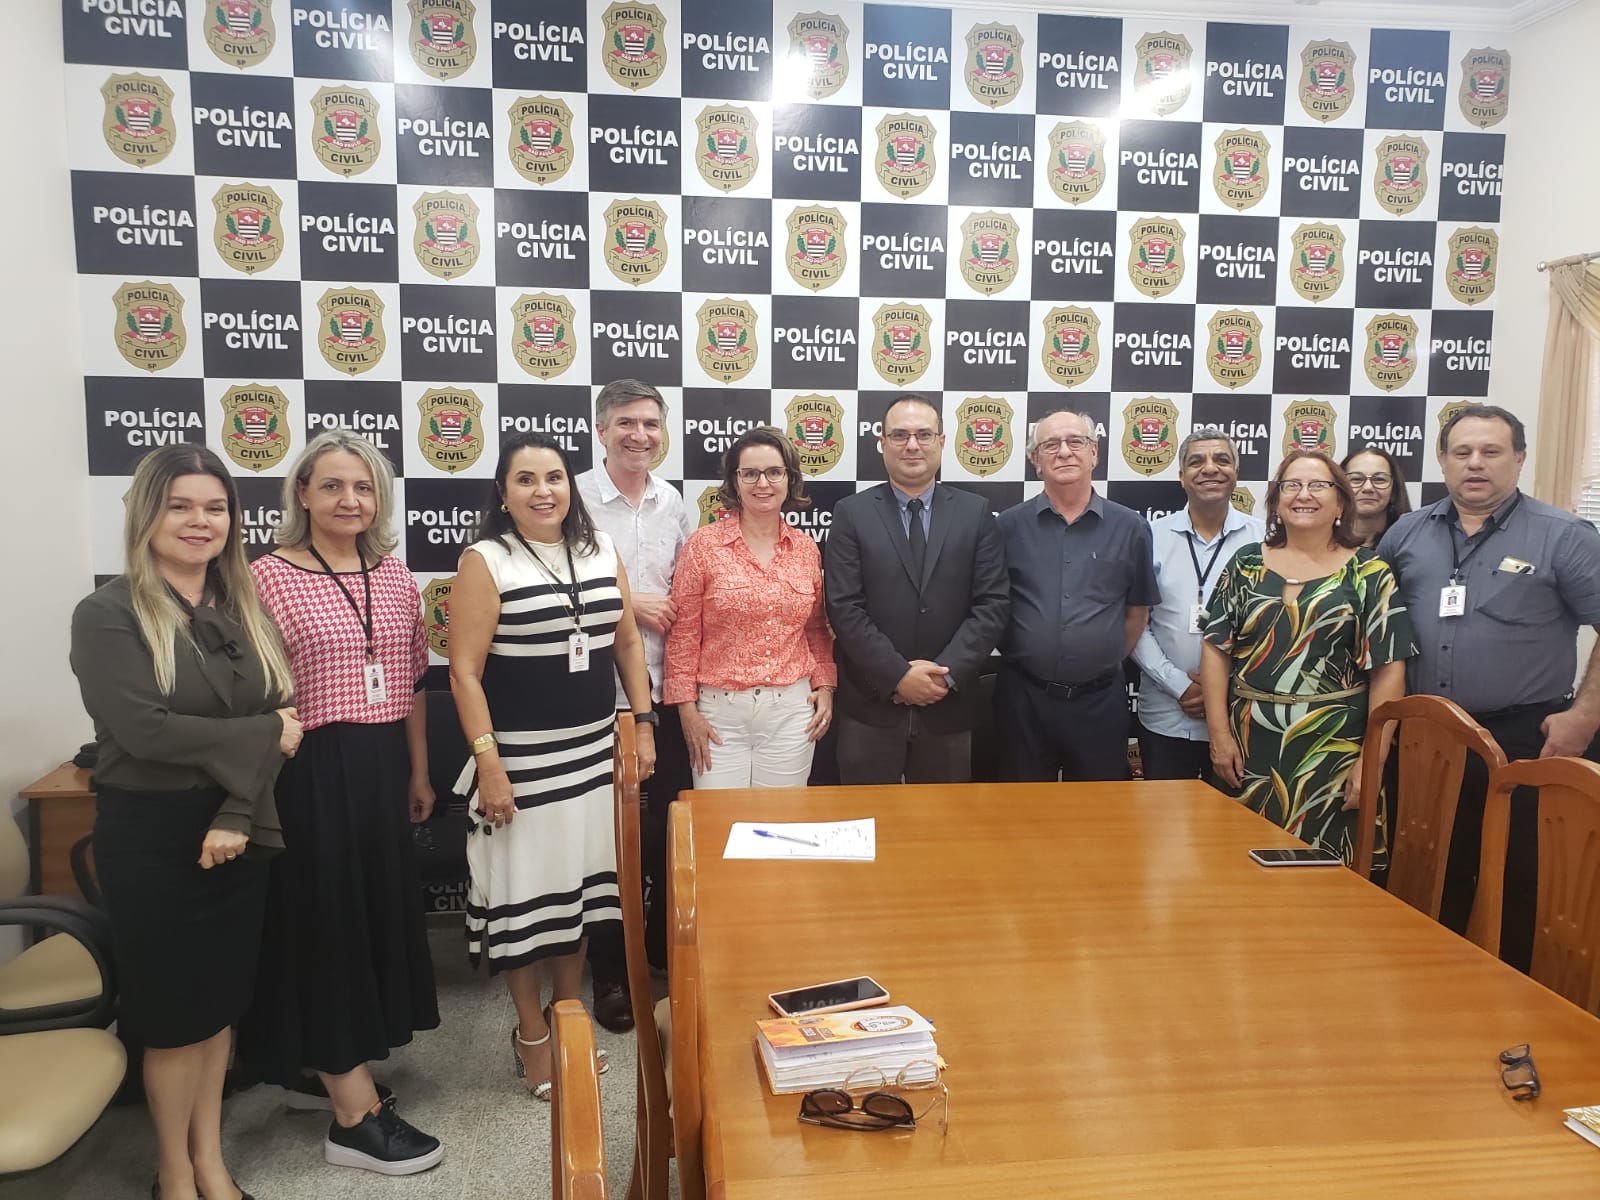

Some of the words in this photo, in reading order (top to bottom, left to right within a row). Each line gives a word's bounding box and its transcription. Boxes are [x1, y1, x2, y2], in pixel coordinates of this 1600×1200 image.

[294, 8, 389, 31] POLÍCIA
[615, 8, 653, 22] POLÍCIA
[105, 17, 171, 37] CIVIL
[494, 21, 585, 44] POLÍCIA
[800, 19, 836, 32] POLÍCIA
[315, 30, 378, 50] CIVIL
[683, 31, 770, 53] POLÍCIA
[977, 29, 1012, 42] POLÍCIA
[223, 43, 257, 54] CIVIL
[1147, 38, 1180, 51] POLÍCIA
[514, 43, 574, 62] CIVIL
[865, 41, 948, 63] POLÍCIA
[1312, 47, 1344, 59] POLÍCIA
[427, 56, 459, 67] CIVIL
[702, 53, 759, 72] CIVIL
[1039, 51, 1118, 72] POLÍCIA
[619, 67, 650, 77] CIVIL
[883, 62, 937, 81] CIVIL
[1207, 59, 1283, 80] POLÍCIA
[1055, 72, 1108, 90] CIVIL
[1370, 67, 1444, 87] POLÍCIA
[116, 81, 158, 95] POLÍCIA
[979, 86, 1008, 95] CIVIL
[1223, 79, 1273, 97] CIVIL
[1385, 86, 1434, 103] CIVIL
[324, 93, 365, 107] POLÍCIA
[1312, 101, 1339, 110] CIVIL
[521, 103, 560, 116] POLÍCIA
[195, 106, 292, 129] POLÍCIA
[708, 112, 745, 124] POLÍCIA
[398, 116, 490, 138] POLÍCIA
[888, 120, 924, 133] POLÍCIA
[217, 128, 280, 148] CIVIL
[590, 125, 678, 147] POLÍCIA
[1226, 136, 1259, 148] POLÍCIA
[123, 143, 157, 153] CIVIL
[418, 138, 479, 157] CIVIL
[775, 133, 859, 155] POLÍCIA
[1387, 142, 1418, 153] POLÍCIA
[330, 153, 363, 164] CIVIL
[609, 147, 667, 165] CIVIL
[951, 141, 1032, 162] POLÍCIA
[1121, 148, 1198, 168] POLÍCIA
[526, 162, 557, 172] CIVIL
[793, 155, 848, 172] CIVIL
[968, 162, 1022, 179] CIVIL
[1284, 155, 1359, 175] POLÍCIA
[1443, 160, 1502, 180] POLÍCI
[711, 169, 742, 179] CIVIL
[1137, 168, 1188, 185] CIVIL
[891, 177, 920, 186] CIVIL
[1062, 183, 1090, 192] CIVIL
[1300, 175, 1349, 191] CIVIL
[226, 191, 268, 204] POLÍCIA
[1227, 190, 1254, 199] CIVIL
[1387, 195, 1413, 204] CIVIL
[426, 199, 465, 211] POLÍCIA
[616, 206, 654, 218] POLÍCIA
[95, 204, 193, 227] POLÍCIA
[798, 213, 834, 225] POLÍCIA
[301, 213, 395, 234] POLÍCIA
[497, 220, 586, 241] POLÍCIA
[973, 219, 1007, 231] POLÍCIA
[1141, 224, 1174, 235] POLÍCIA
[117, 227, 182, 246] CIVIL
[684, 226, 769, 247] POLÍCIA
[862, 232, 944, 252] POLÍCIA
[1303, 229, 1334, 241] POLÍCIA
[1459, 233, 1489, 245] POLÍCIA
[322, 235, 384, 253] CIVIL
[517, 241, 575, 259] CIVIL
[1034, 237, 1113, 257] POLÍCIA
[232, 251, 266, 261] CIVIL
[702, 248, 758, 265] CIVIL
[1200, 242, 1275, 262] POLÍCIA
[1359, 247, 1431, 266] POLÍCIA
[431, 257, 463, 267] CIVIL
[620, 263, 651, 273] CIVIL
[880, 253, 934, 270] CIVIL
[1051, 258, 1102, 274] CIVIL
[801, 269, 830, 278] CIVIL
[1215, 262, 1265, 279] CIVIL
[1374, 267, 1422, 283] CIVIL
[975, 274, 1003, 283] CIVIL
[1142, 278, 1169, 287] CIVIL
[1303, 282, 1329, 291] CIVIL
[1458, 285, 1484, 294] CIVIL
[127, 289, 169, 301] POLÍCIA
[331, 295, 370, 307] POLÍCIA
[524, 300, 562, 312] POLÍCIA
[709, 306, 745, 318] POLÍCIA
[204, 310, 299, 331] POLÍCIA
[885, 310, 919, 322] POLÍCIA
[1055, 313, 1088, 324] POLÍCIA
[1219, 316, 1251, 327] POLÍCIA
[403, 314, 493, 335] POLÍCIA
[593, 320, 679, 340] POLÍCIA
[1377, 320, 1407, 331] POLÍCIA
[225, 332, 288, 349] CIVIL
[773, 325, 856, 344] POLÍCIA
[947, 328, 1026, 347] POLÍCIA
[1115, 330, 1191, 349] POLÍCIA
[422, 336, 482, 353] CIVIL
[612, 341, 669, 358] CIVIL
[1276, 333, 1349, 352] POLÍCIA
[1432, 336, 1490, 354] POLÍCI
[134, 348, 168, 358] CIVIL
[336, 353, 369, 363] CIVIL
[791, 346, 846, 362] CIVIL
[963, 348, 1016, 364] CIVIL
[1131, 350, 1181, 366] CIVIL
[529, 357, 560, 367] CIVIL
[712, 362, 742, 371] CIVIL
[1291, 353, 1340, 368] CIVIL
[887, 365, 916, 374] CIVIL
[1056, 366, 1084, 375] CIVIL
[1220, 369, 1246, 377] CIVIL
[1377, 371, 1402, 380] CIVIL
[235, 391, 275, 403] POLÍCIA
[431, 394, 470, 406] POLÍCIA
[797, 401, 832, 413] POLÍCIA
[968, 403, 1002, 414] POLÍCIA
[1135, 404, 1167, 415] POLÍCIA
[1295, 406, 1326, 417] POLÍCIA
[106, 407, 202, 428] POLÍCIA
[308, 409, 399, 430] POLÍCIA
[501, 413, 589, 433] POLÍCIA
[1350, 422, 1422, 440] POLÍCIA
[703, 437, 735, 453] CIV
[241, 449, 274, 459] CIVIL
[436, 451, 467, 460] CIVIL
[800, 456, 828, 465] CIVIL
[970, 457, 997, 465] CIVIL
[1136, 456, 1163, 465] CIVIL
[408, 506, 482, 526] POLÍCI
